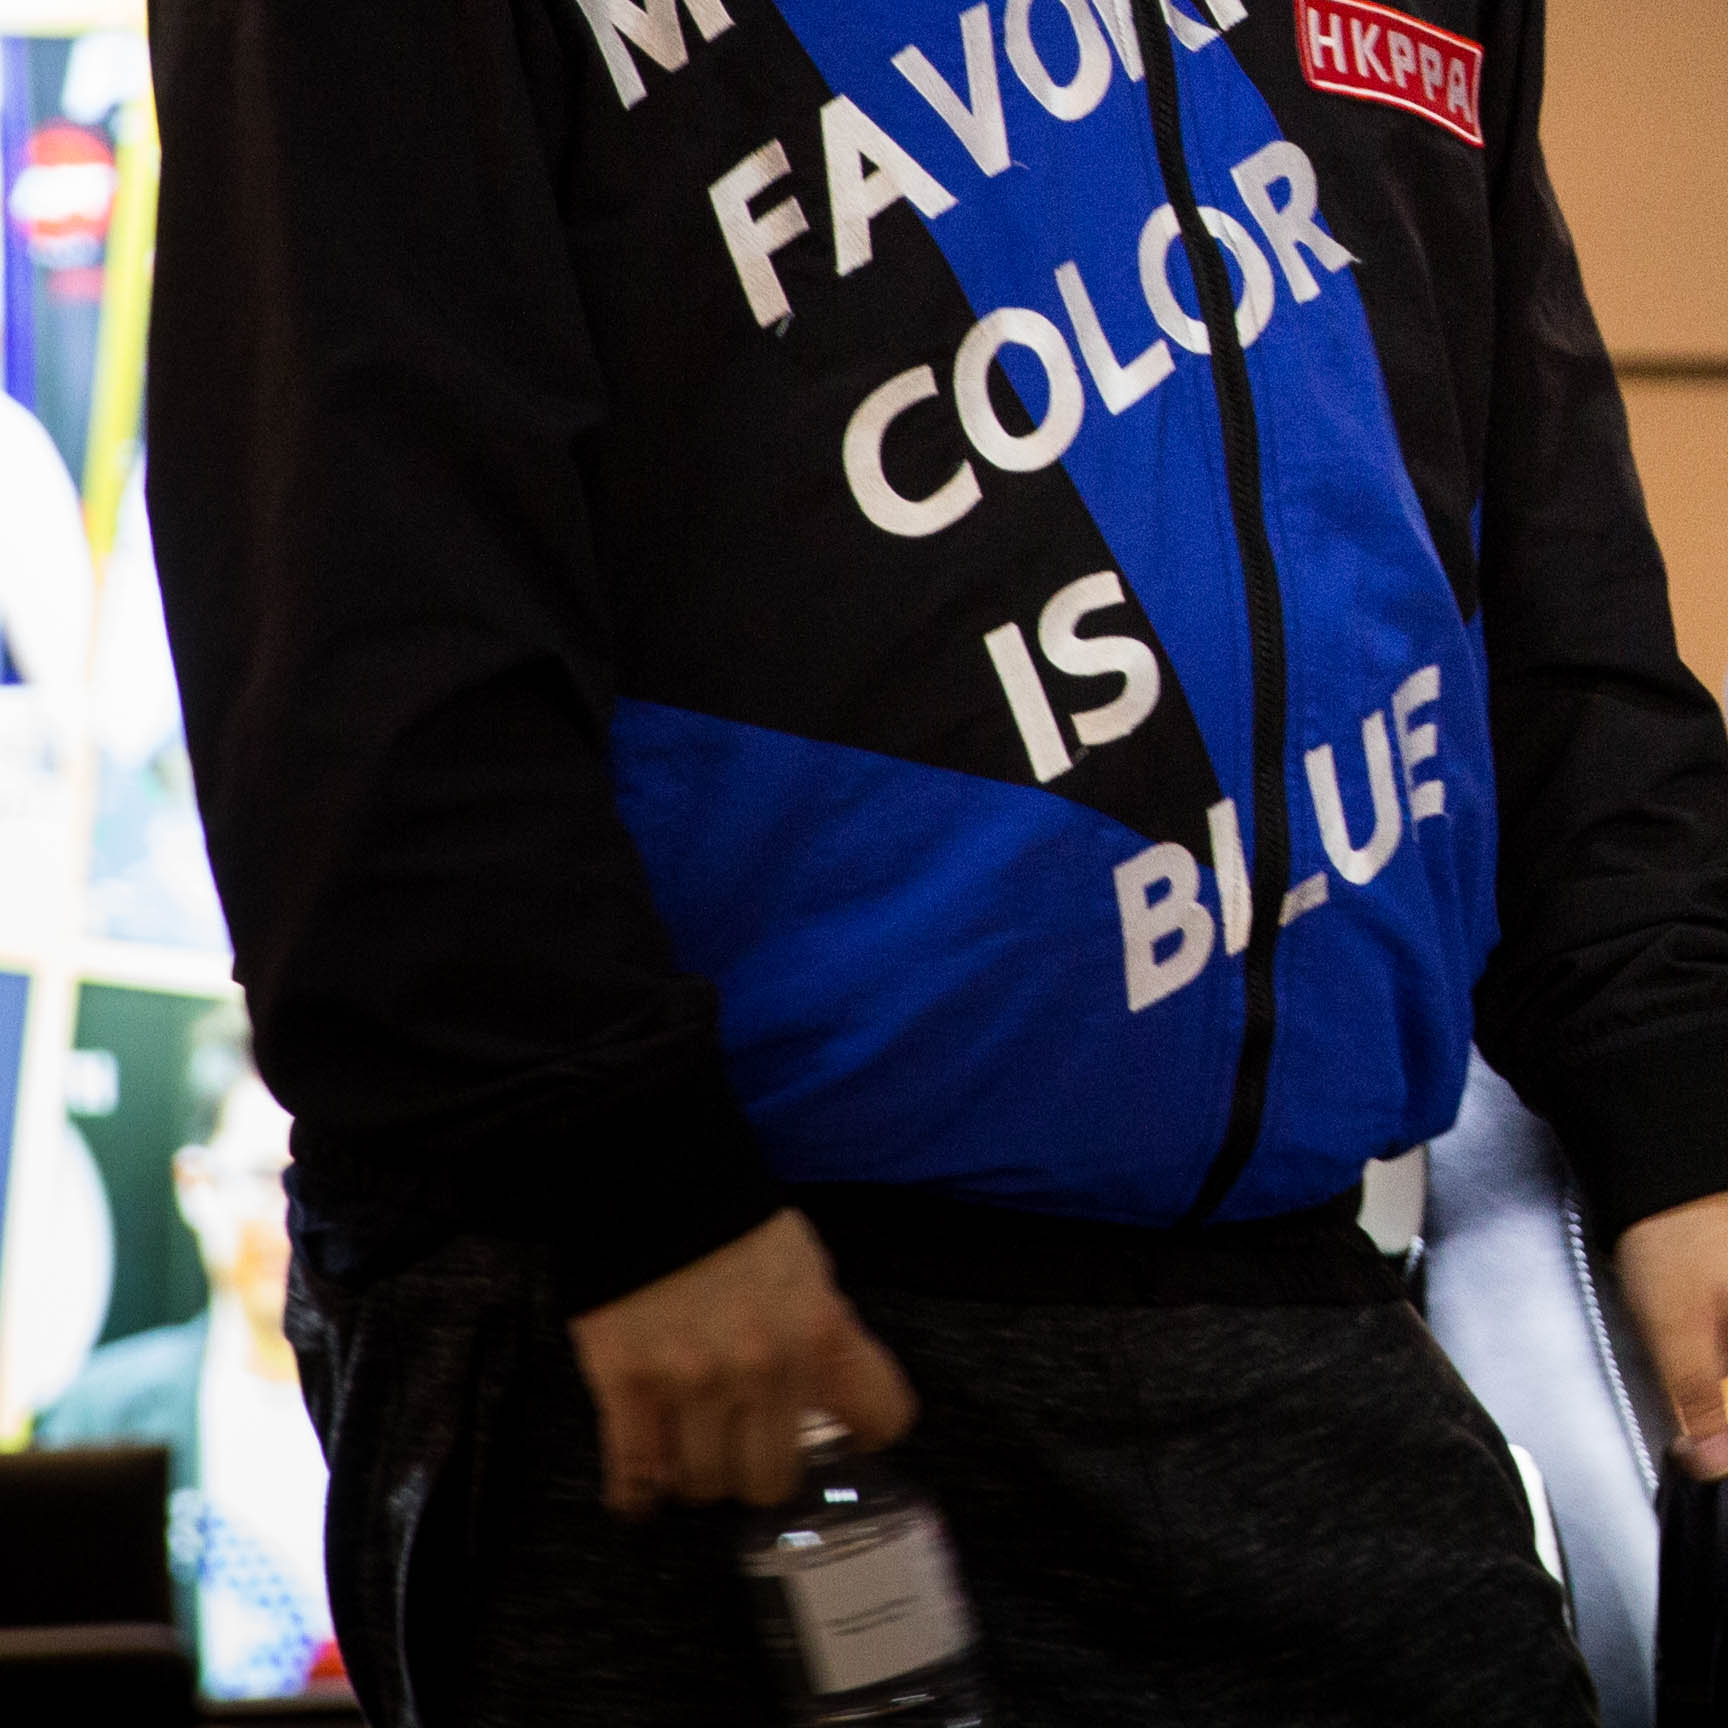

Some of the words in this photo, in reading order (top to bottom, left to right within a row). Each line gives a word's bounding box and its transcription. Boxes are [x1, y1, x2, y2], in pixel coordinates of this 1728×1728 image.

[1306, 6, 1473, 125] HKPPA
[842, 139, 1358, 538] COLOR
[982, 570, 1162, 784] IS
[1111, 664, 1446, 1014] BLUE
